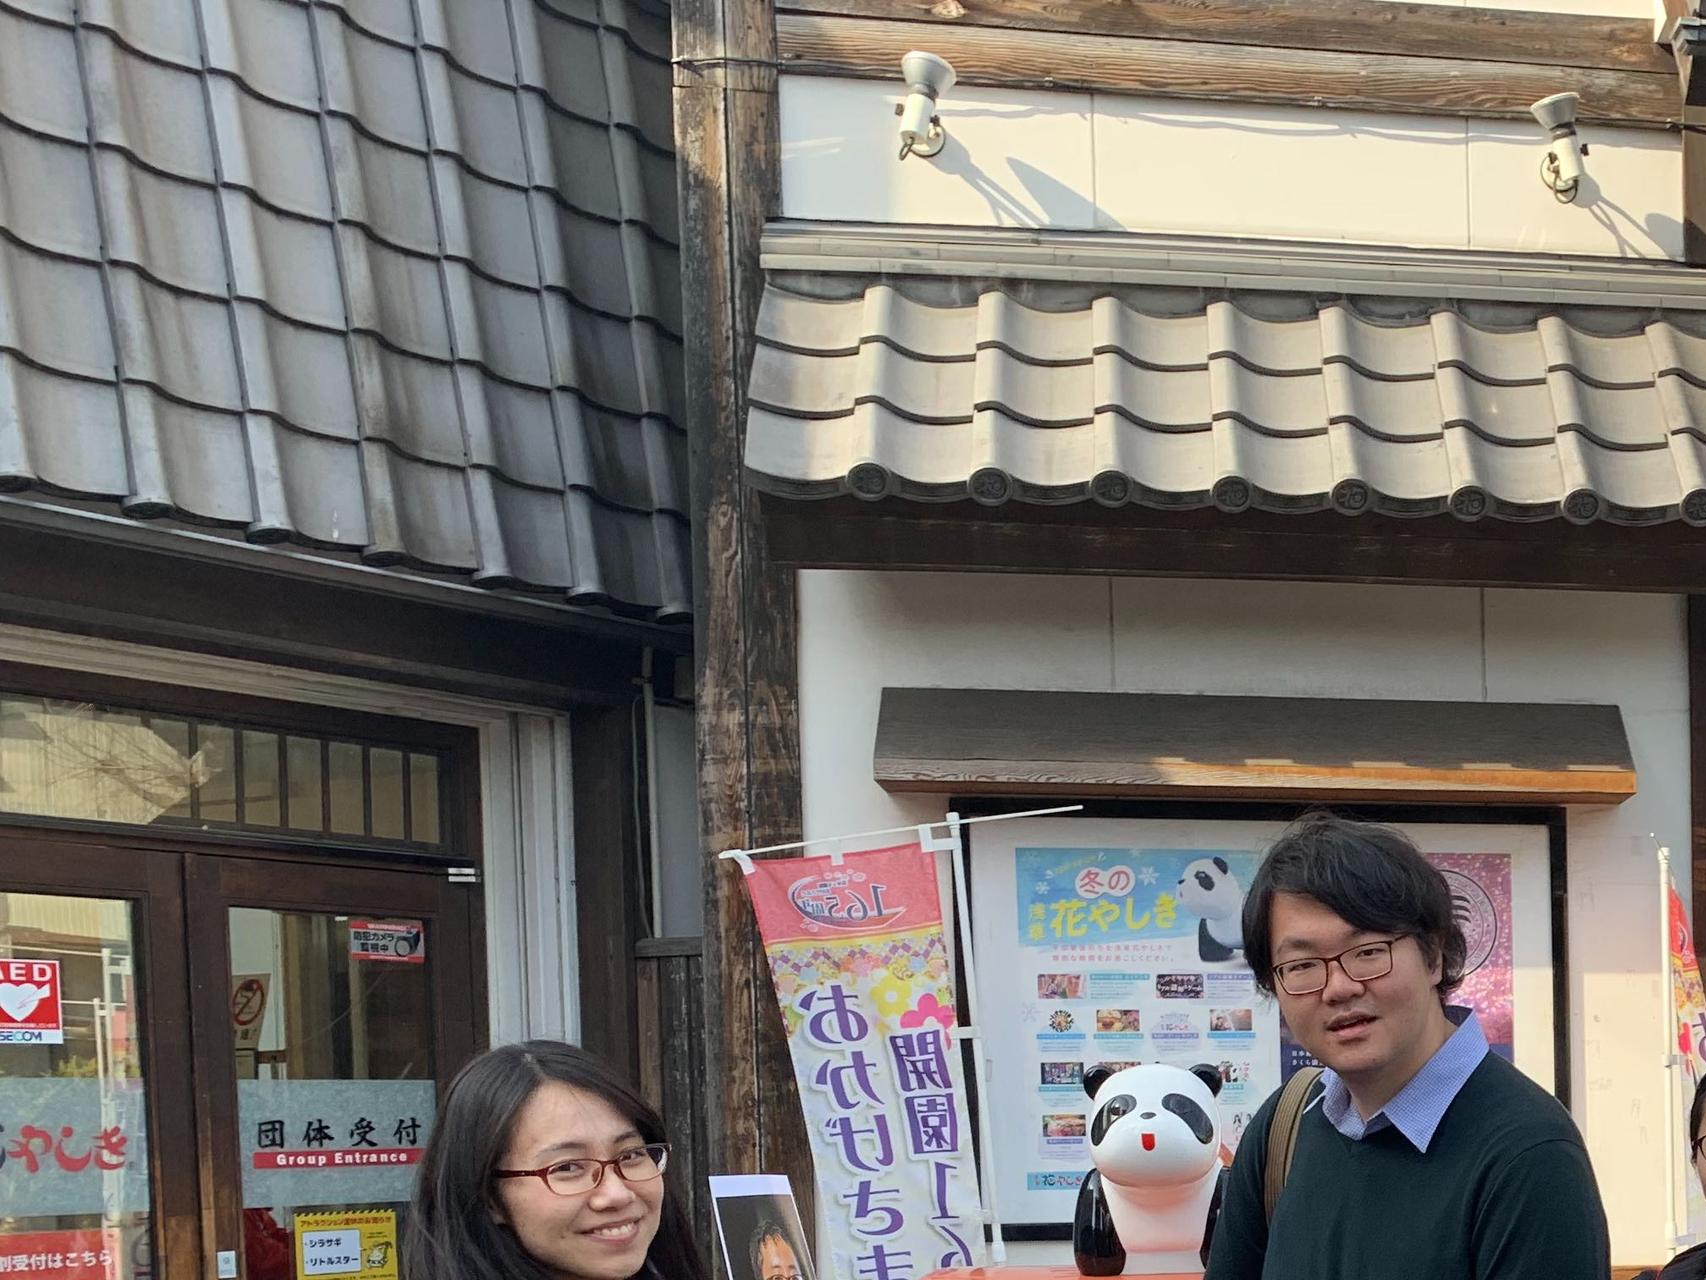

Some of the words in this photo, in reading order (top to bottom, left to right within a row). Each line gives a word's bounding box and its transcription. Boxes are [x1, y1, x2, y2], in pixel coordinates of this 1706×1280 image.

[1079, 868, 1131, 895] 冬の
[1051, 892, 1179, 938] 花やしき
[0, 962, 53, 981] ED
[257, 1117, 422, 1149] 団体受付
[0, 1123, 128, 1174] やしき
[276, 1153, 327, 1167] Group
[334, 1152, 408, 1164] Entrance
